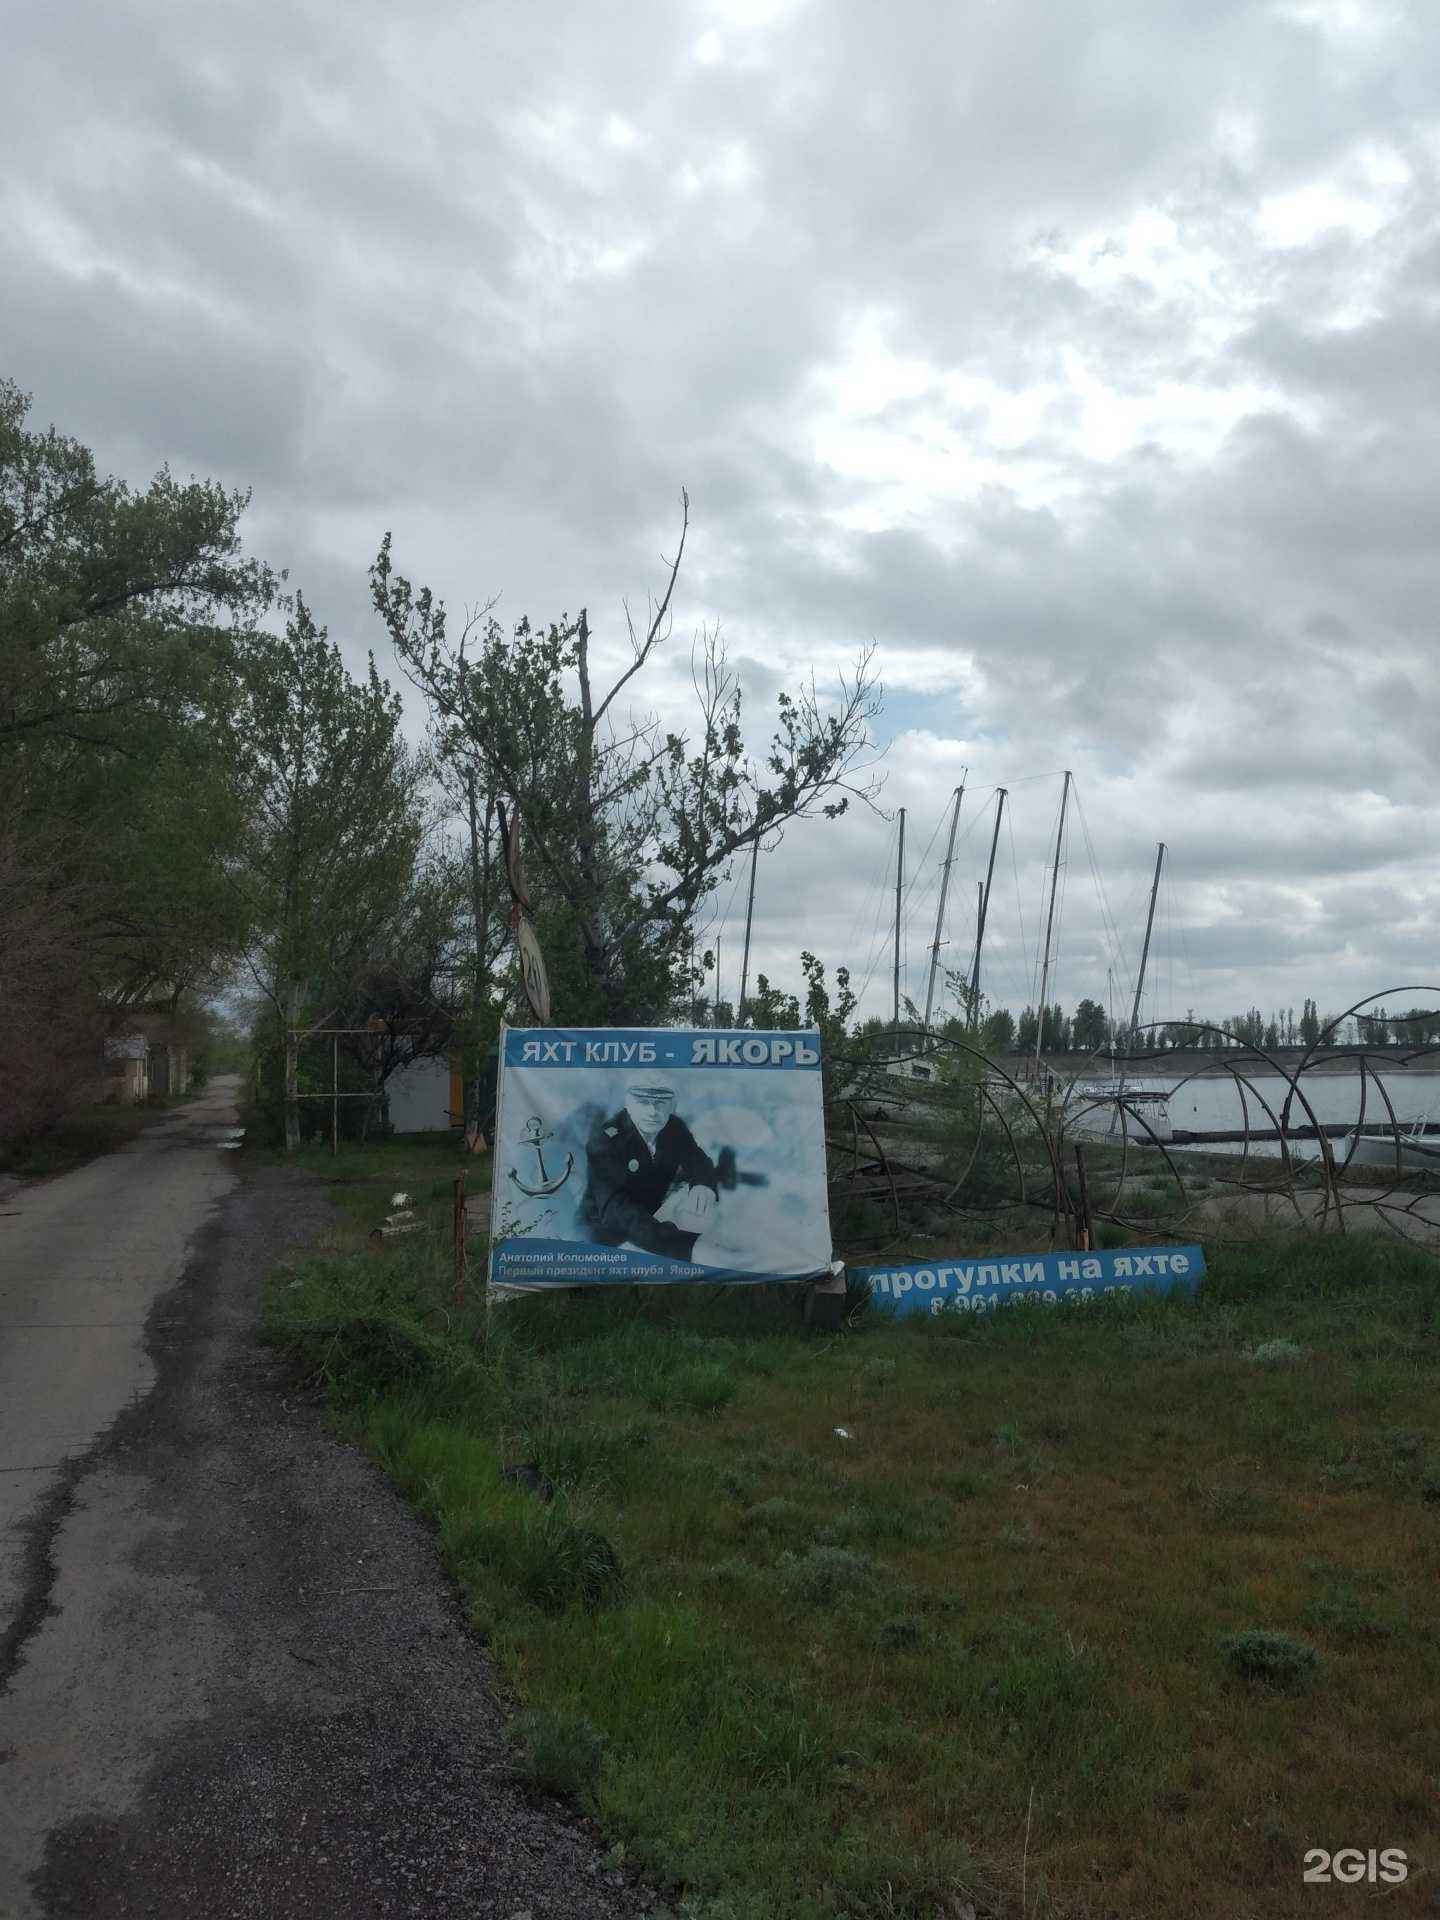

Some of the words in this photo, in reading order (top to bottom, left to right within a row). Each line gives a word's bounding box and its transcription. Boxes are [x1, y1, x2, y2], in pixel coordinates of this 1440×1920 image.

[521, 1041, 577, 1063] ЯХТ
[585, 1042, 657, 1063] КЛУБ
[690, 1038, 820, 1065] ЯКОРЬ
[499, 1252, 553, 1263] Анатолий
[868, 1260, 1046, 1298] прогулки
[1058, 1257, 1103, 1281] на
[1113, 1251, 1190, 1278] яхте
